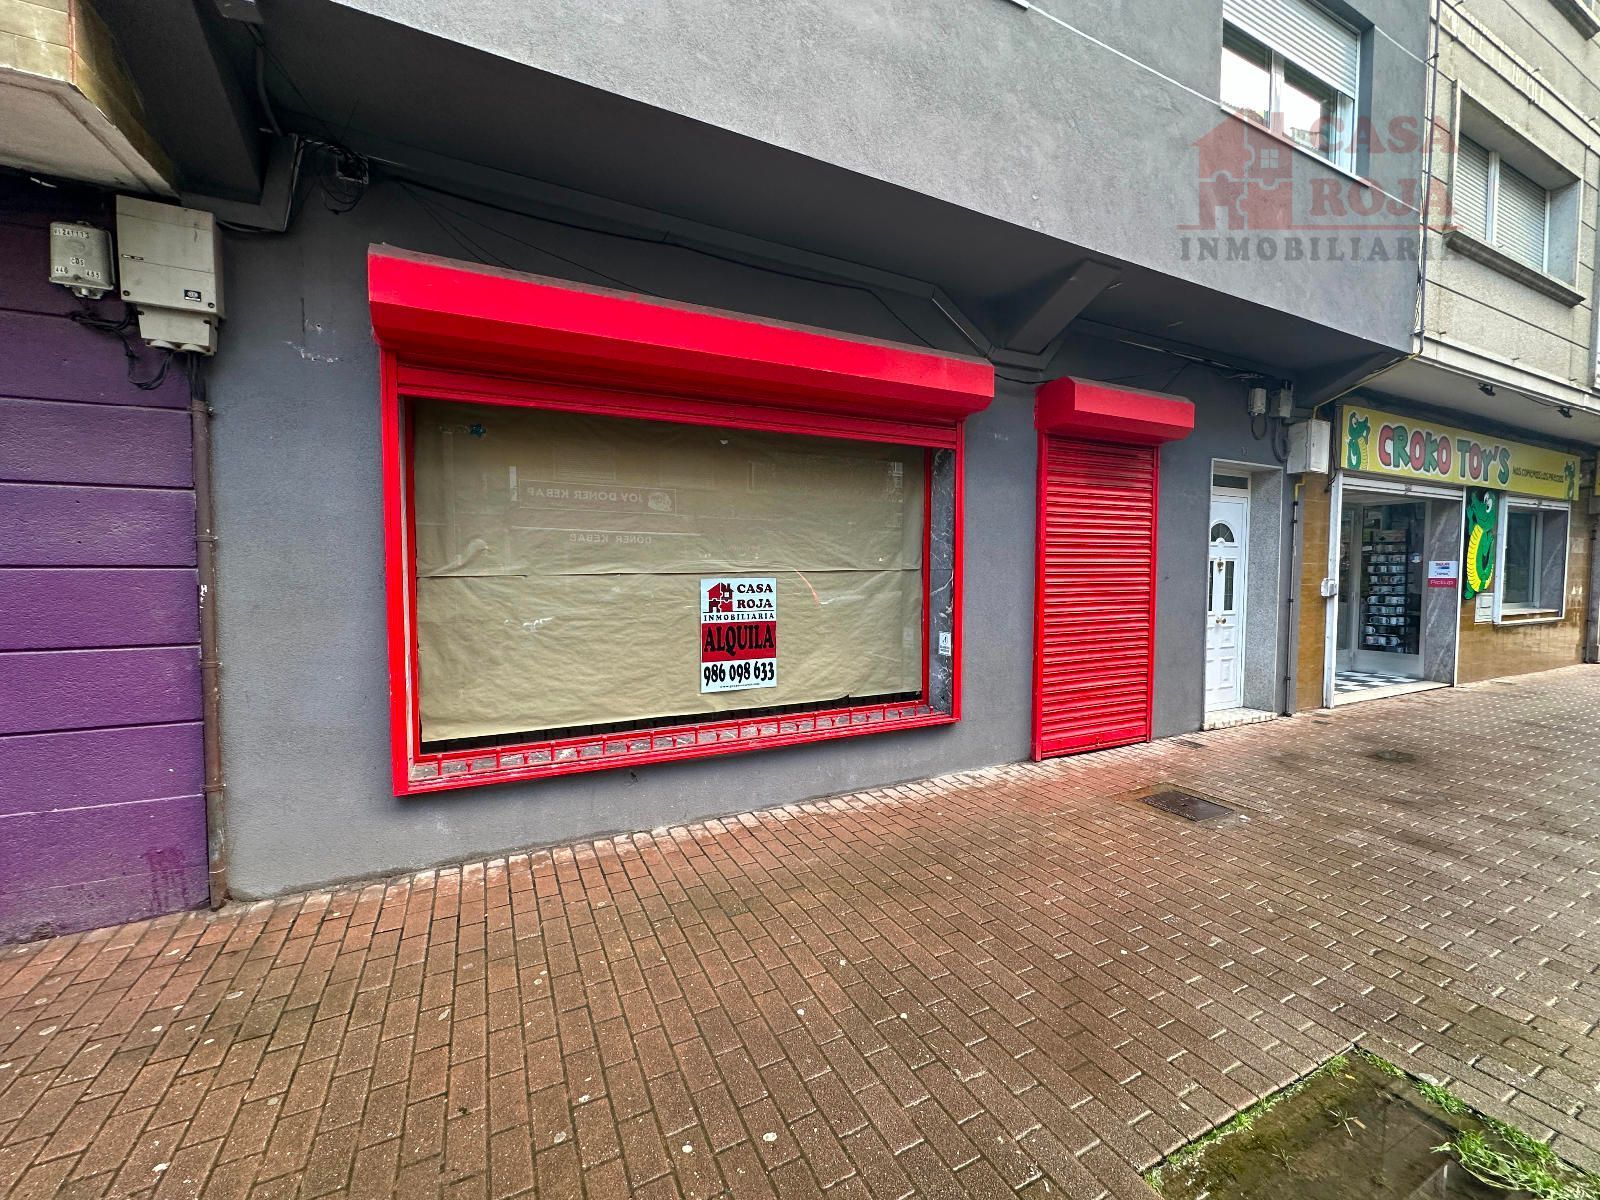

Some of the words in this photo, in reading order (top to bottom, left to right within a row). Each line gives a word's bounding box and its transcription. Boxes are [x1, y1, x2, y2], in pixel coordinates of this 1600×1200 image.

[1379, 424, 1451, 476] CROKO
[1457, 438, 1511, 485] TOY'S
[737, 584, 774, 593] CASA
[737, 599, 774, 608] ROJA
[704, 613, 775, 621] INMOBILIARIA
[704, 624, 775, 656] ALQUILA
[704, 664, 726, 686] 986
[729, 662, 751, 684] 098
[754, 661, 775, 681] 633
